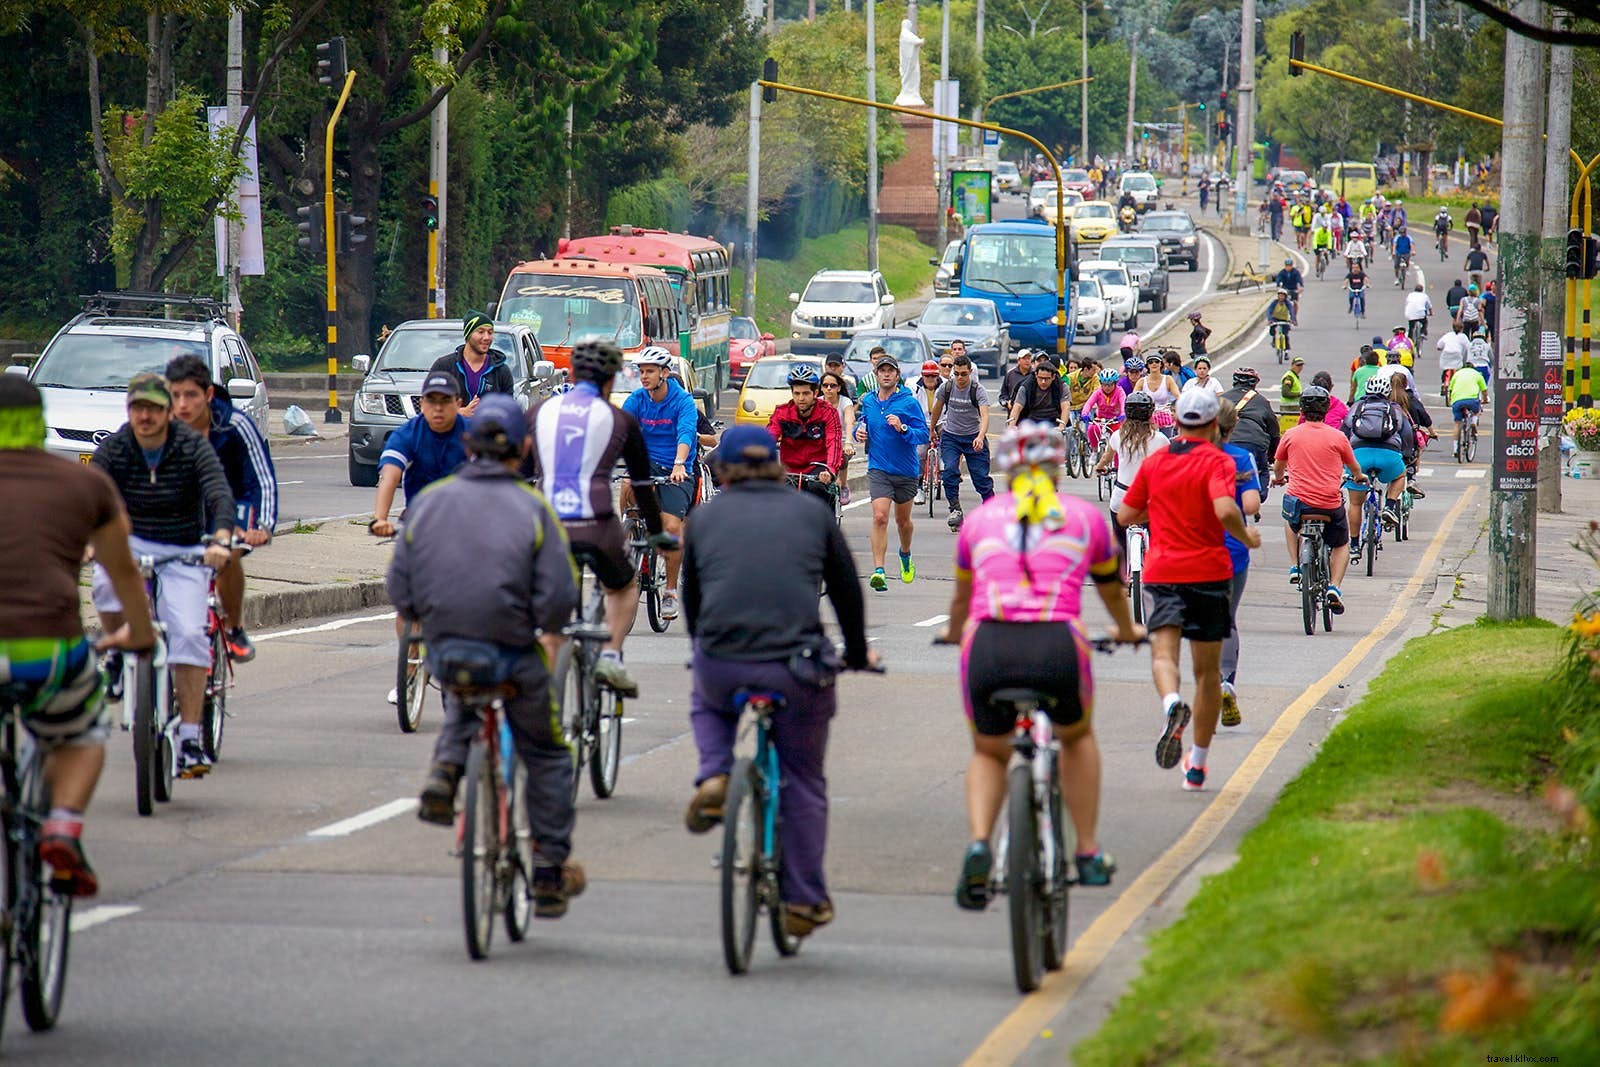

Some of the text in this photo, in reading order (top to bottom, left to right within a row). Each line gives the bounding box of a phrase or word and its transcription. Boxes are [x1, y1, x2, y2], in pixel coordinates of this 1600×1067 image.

[1544, 382, 1562, 391] funky
[1544, 397, 1561, 405] disco
[1506, 419, 1536, 432] funky
[1506, 444, 1535, 456] disco
[1506, 459, 1520, 472] EN
